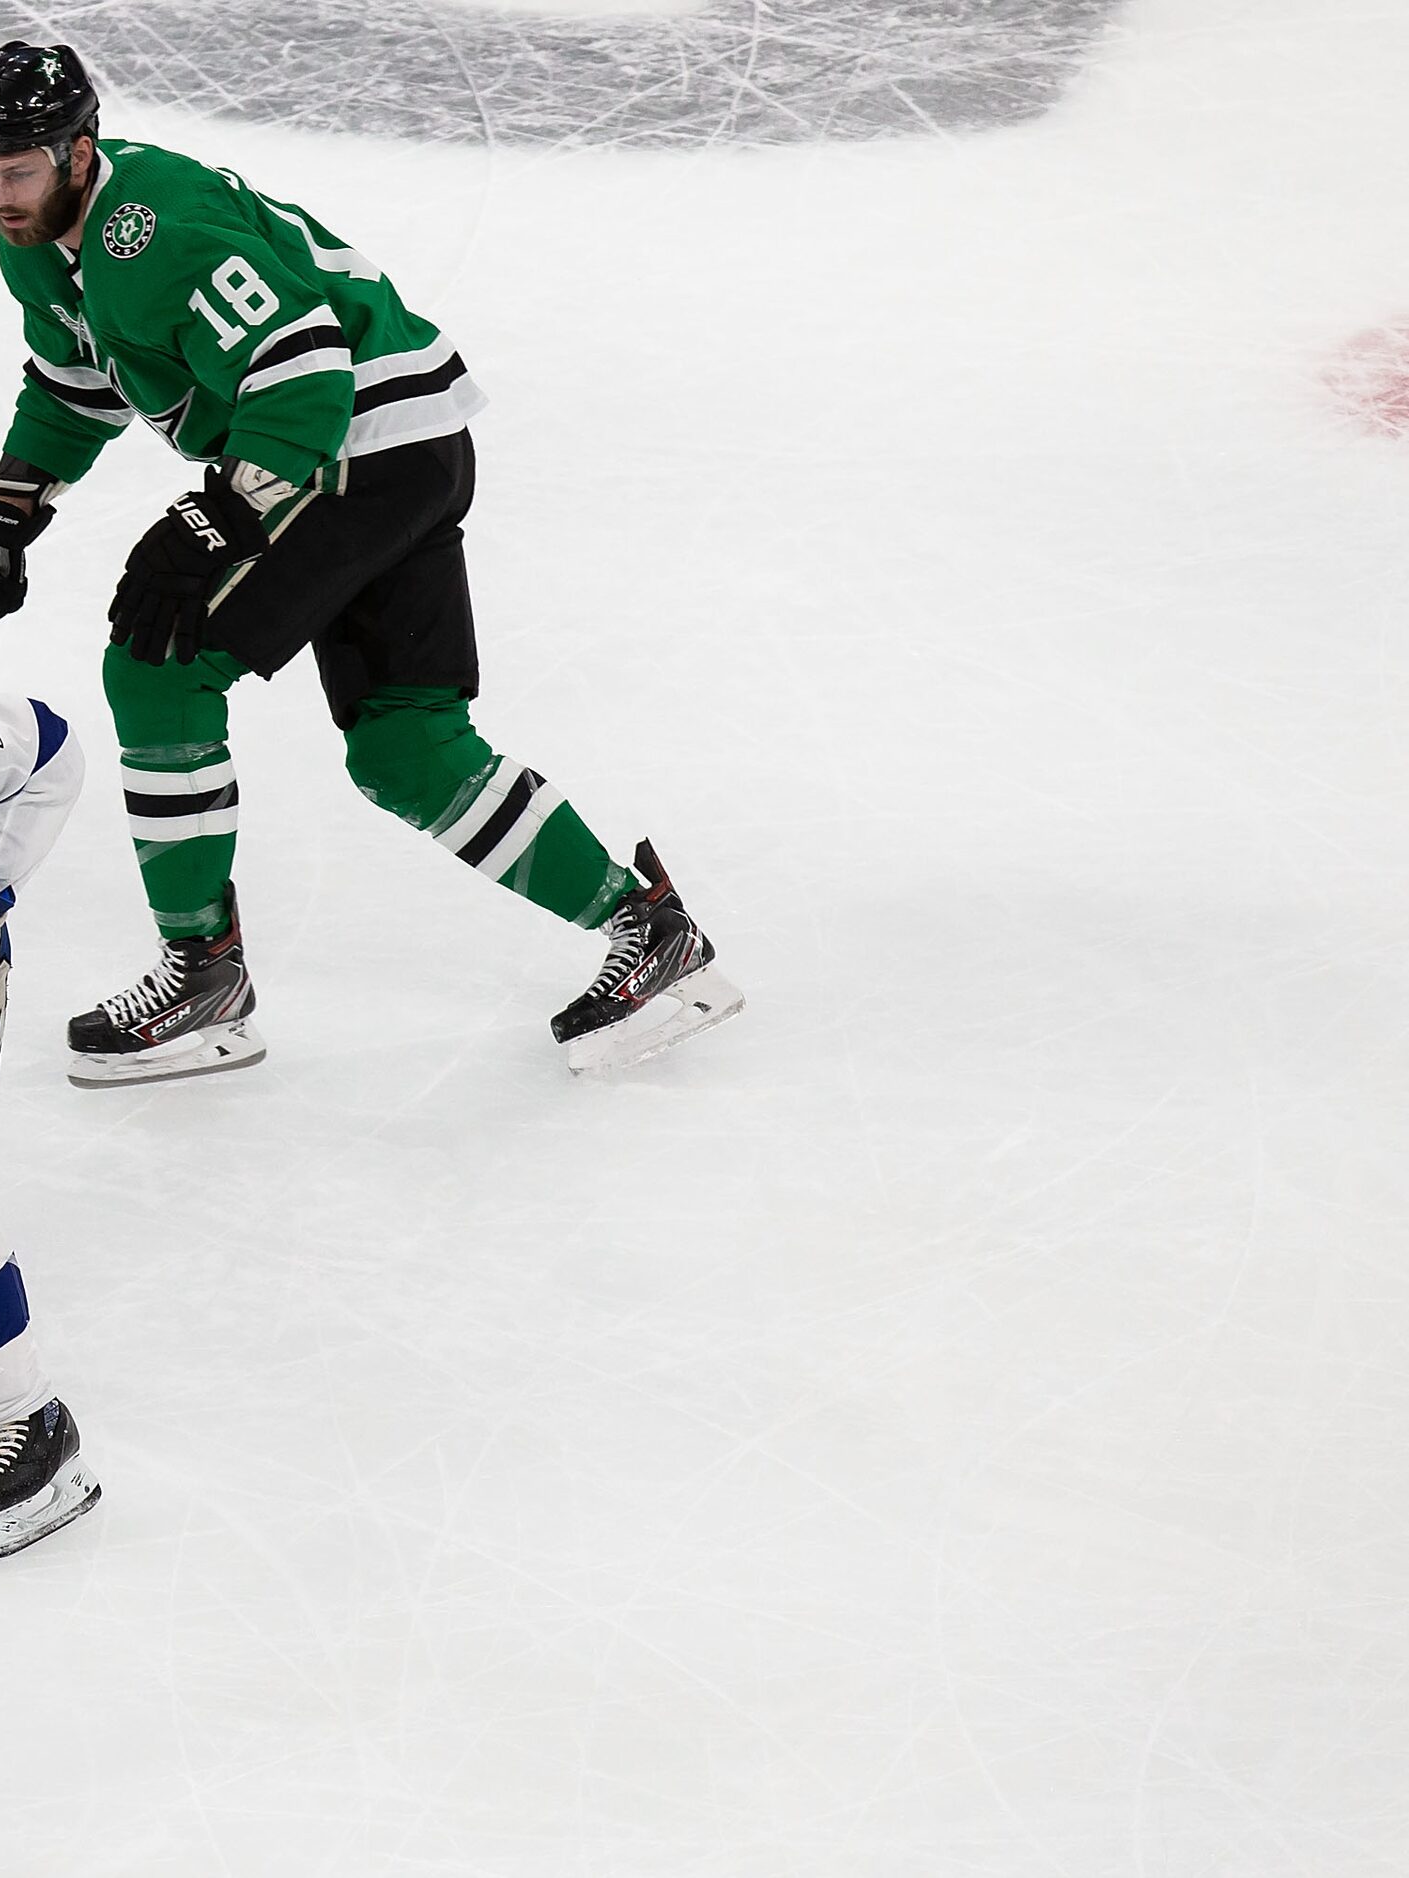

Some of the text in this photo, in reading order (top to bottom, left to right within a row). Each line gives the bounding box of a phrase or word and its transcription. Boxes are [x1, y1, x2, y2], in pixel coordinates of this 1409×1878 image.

[189, 255, 280, 352] 18
[627, 956, 659, 994] CCM
[150, 1005, 191, 1036] CCM
